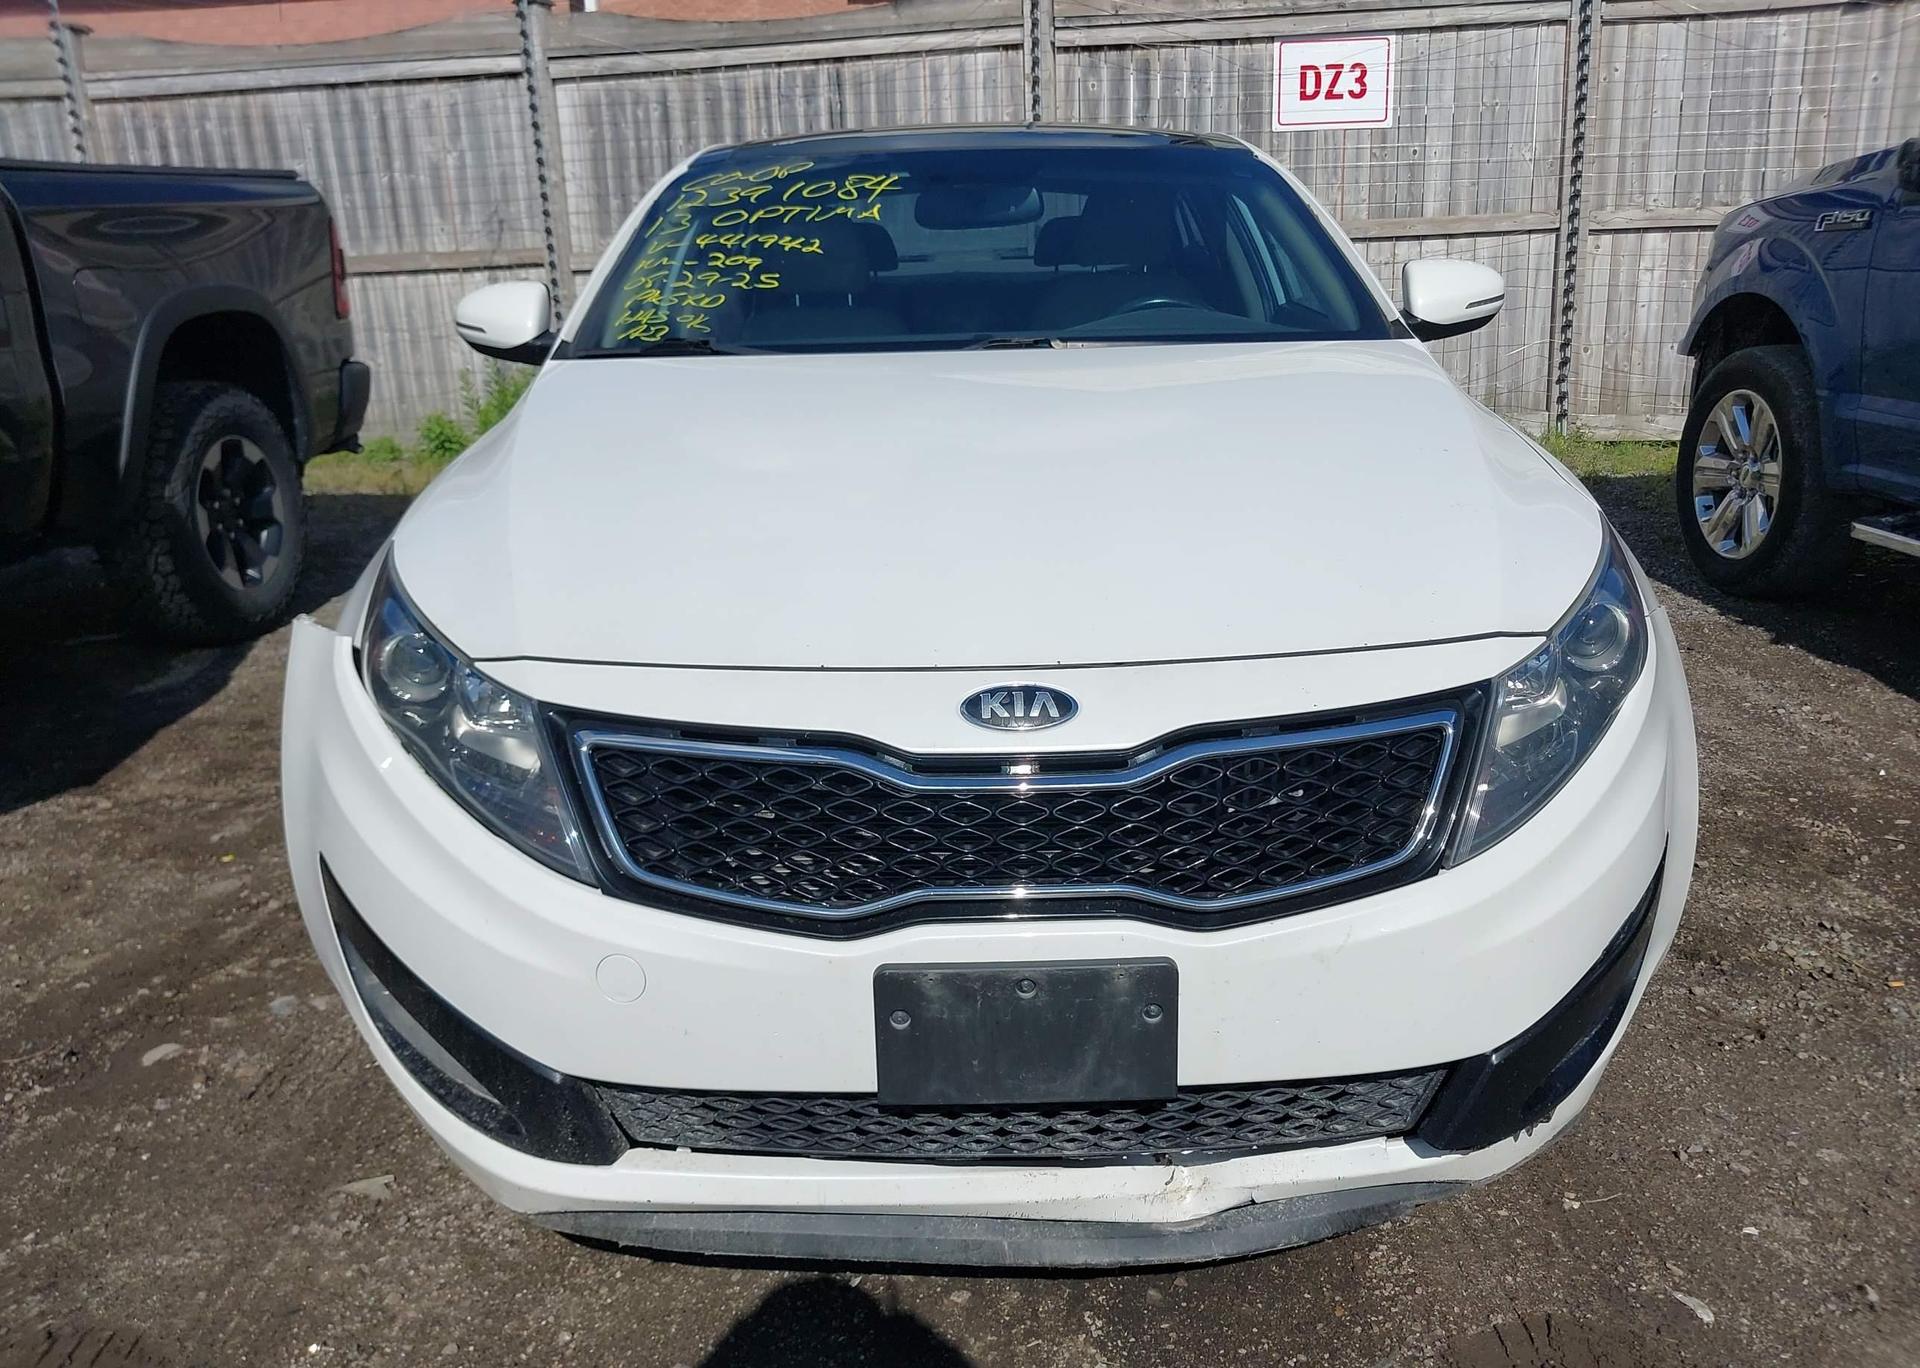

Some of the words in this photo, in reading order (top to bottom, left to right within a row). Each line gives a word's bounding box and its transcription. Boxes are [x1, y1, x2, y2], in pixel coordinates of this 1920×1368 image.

[1299, 62, 1368, 101] DZ3
[643, 213, 693, 239] 13
[711, 203, 882, 228] OPTIMA
[979, 691, 1060, 719] KIA
